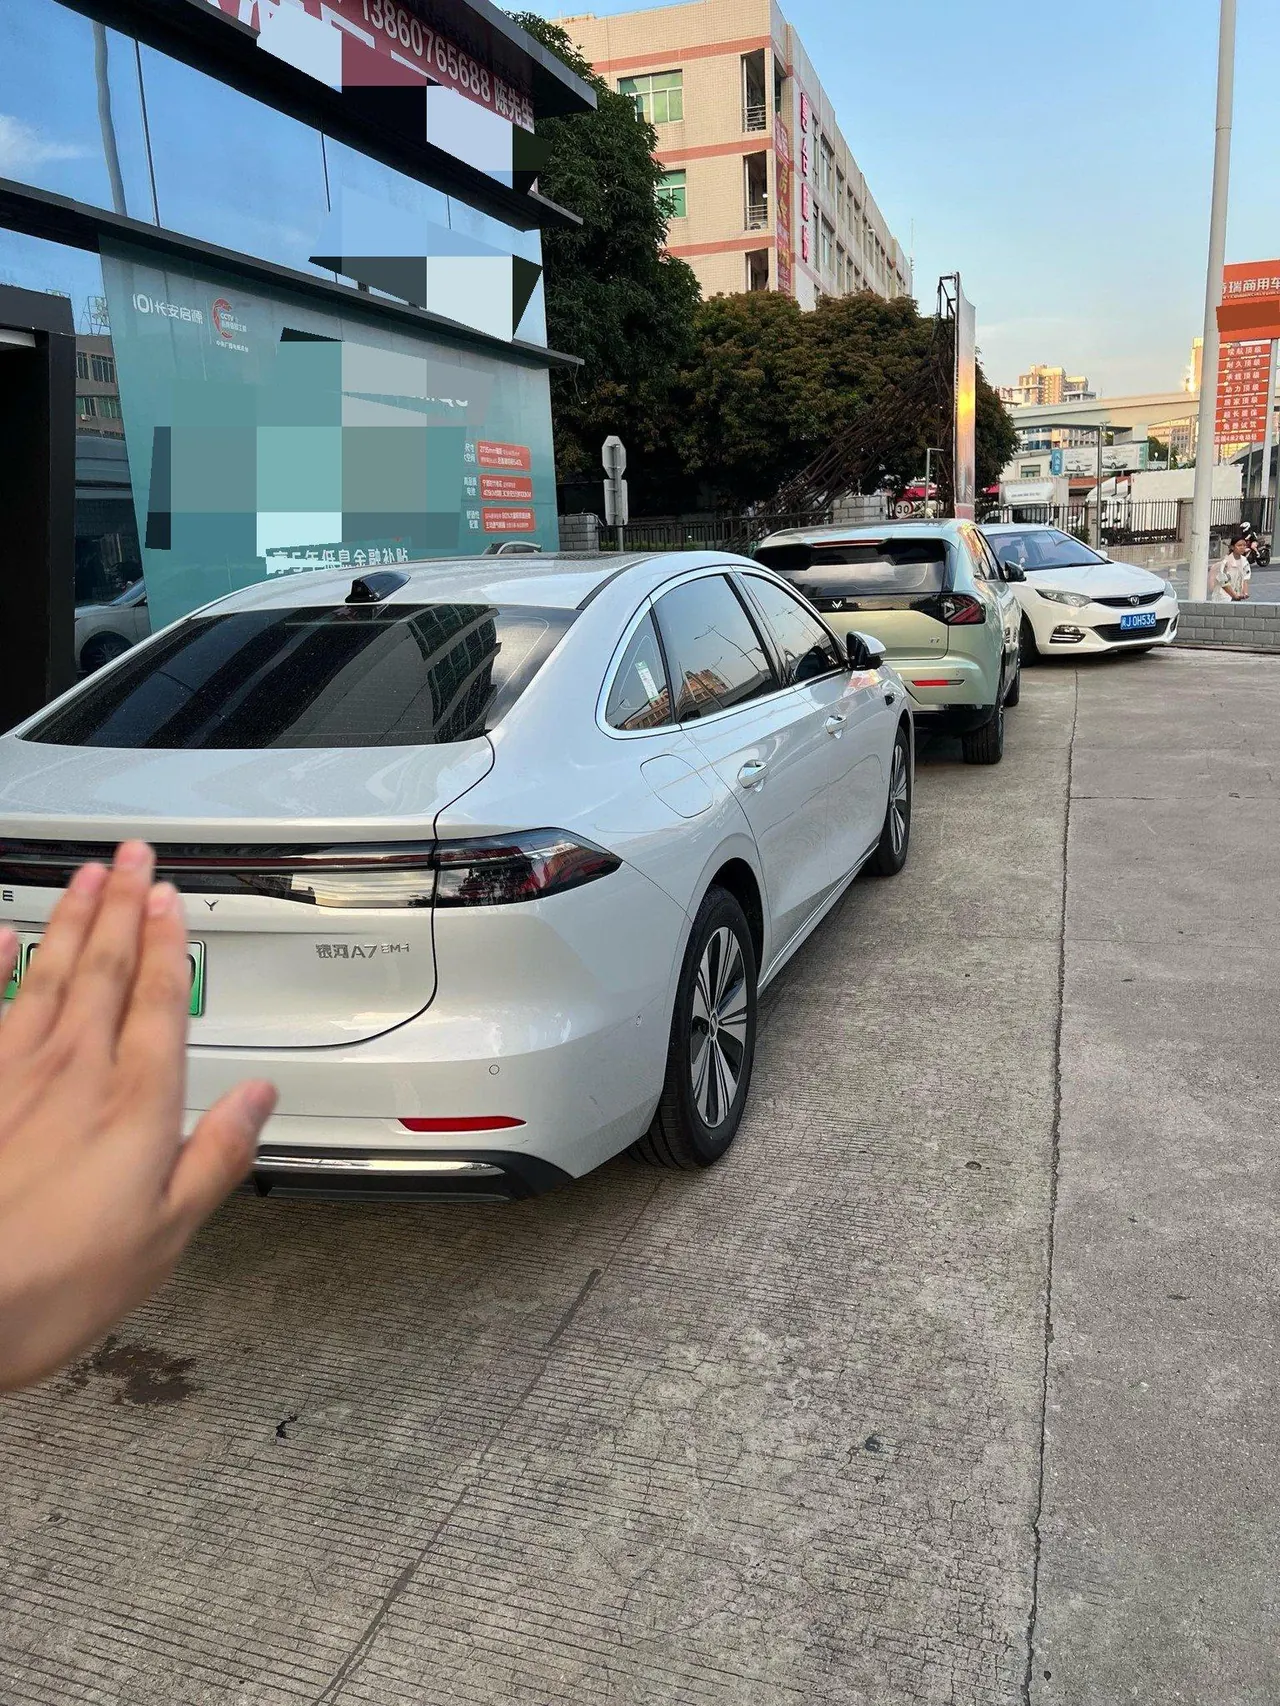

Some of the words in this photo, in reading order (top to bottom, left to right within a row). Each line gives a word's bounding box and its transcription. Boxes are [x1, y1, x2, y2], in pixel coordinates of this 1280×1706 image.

[362, 0, 491, 103] 13860765688
[494, 76, 535, 134] 陈先生
[897, 505, 909, 514] 30
